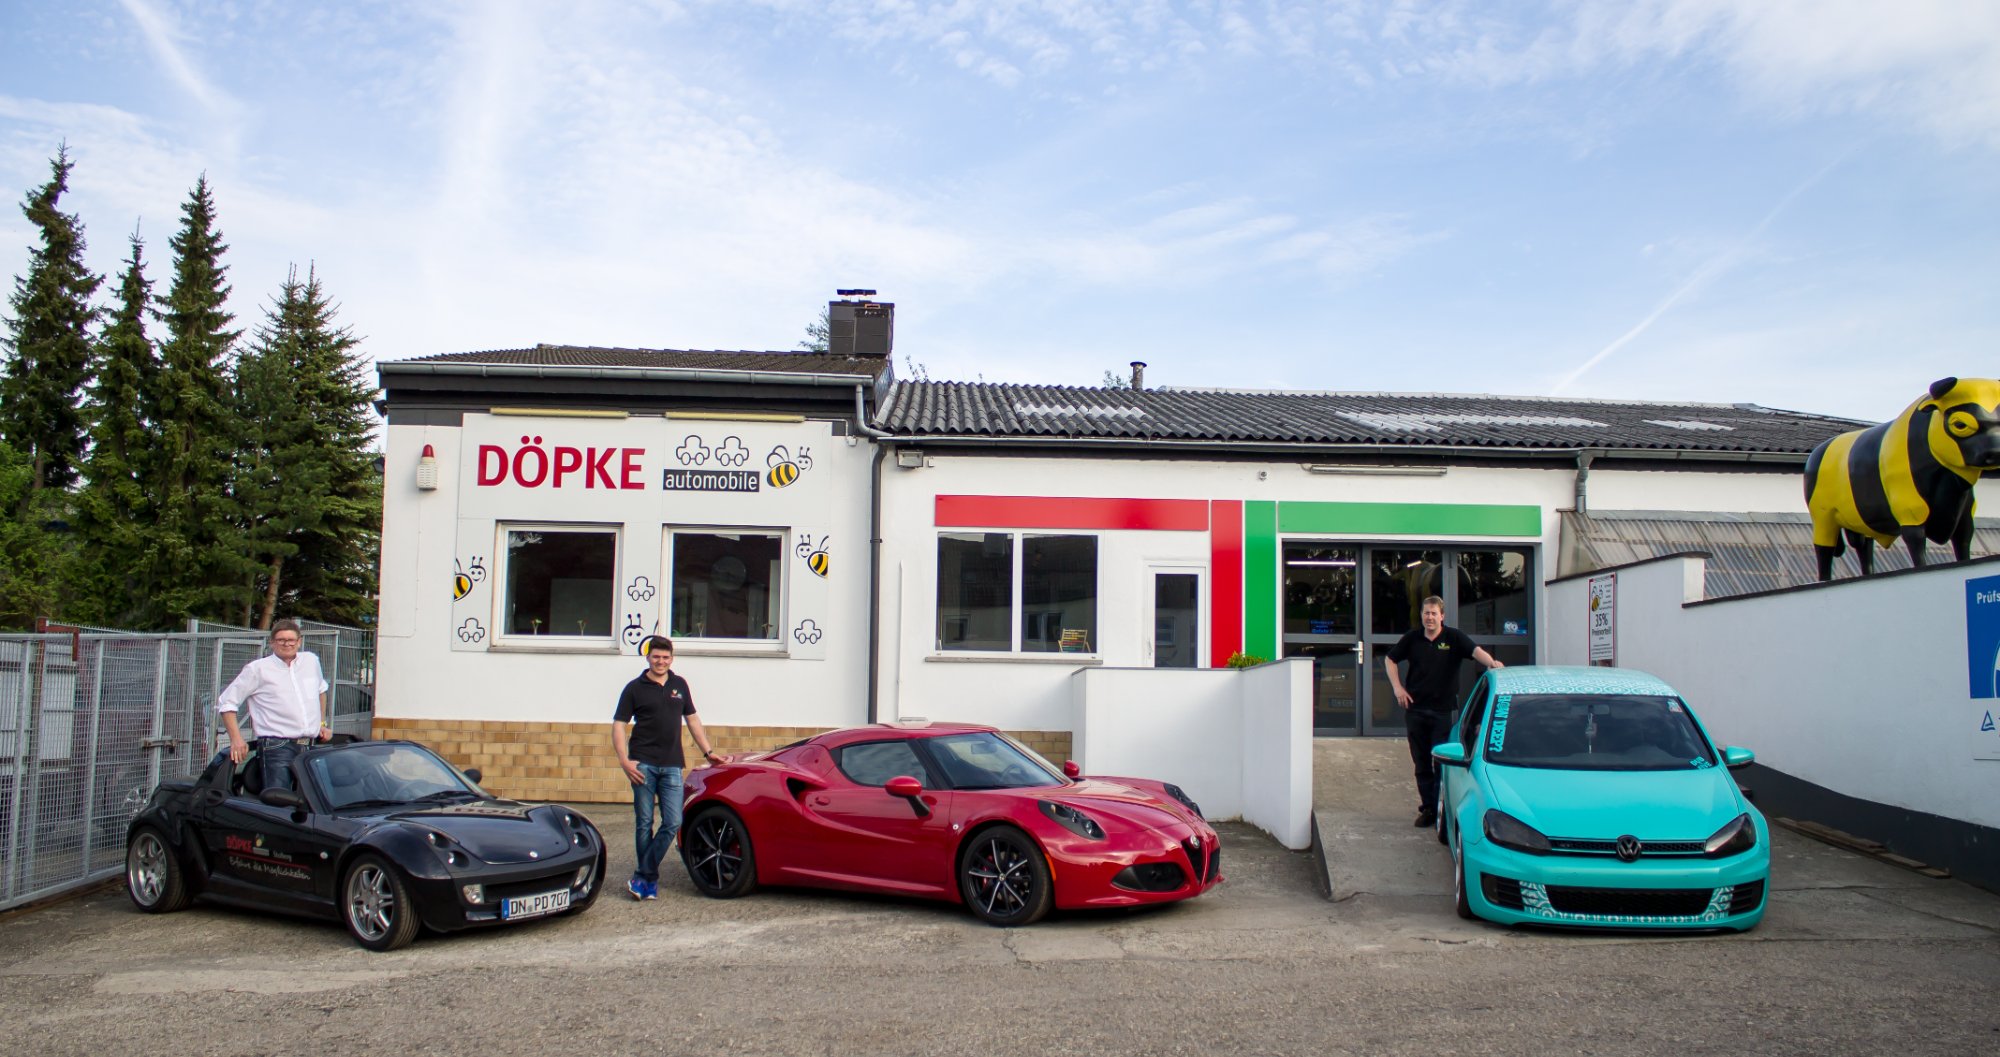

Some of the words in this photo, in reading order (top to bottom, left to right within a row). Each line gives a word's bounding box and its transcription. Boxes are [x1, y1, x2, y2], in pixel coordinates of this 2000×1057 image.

[477, 435, 646, 490] DÖPKE
[664, 471, 759, 491] automobile
[1595, 613, 1609, 627] 35%
[1489, 719, 1508, 752] DEEP?
[226, 834, 253, 853] DÖPKE
[510, 899, 527, 916] DN
[534, 895, 549, 911] PD
[551, 890, 569, 908] 707
